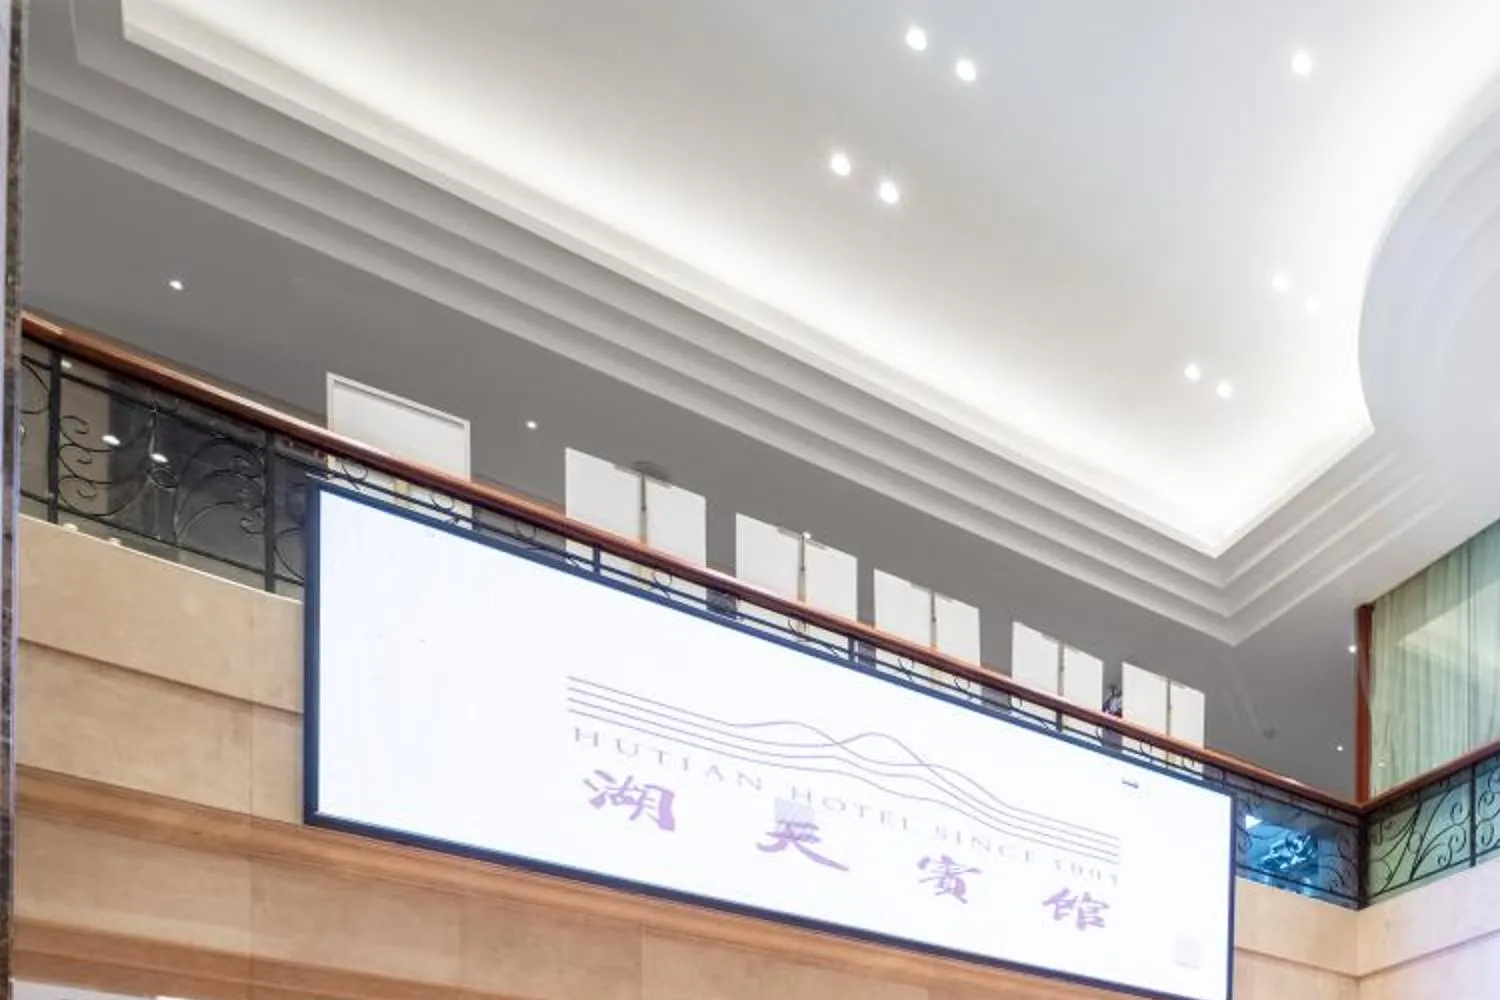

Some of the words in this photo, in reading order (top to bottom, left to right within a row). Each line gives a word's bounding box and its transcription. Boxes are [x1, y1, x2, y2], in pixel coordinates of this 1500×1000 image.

[573, 726, 764, 792] HUTIAN
[791, 784, 912, 833] HOTEL
[934, 822, 1040, 866] SINCE
